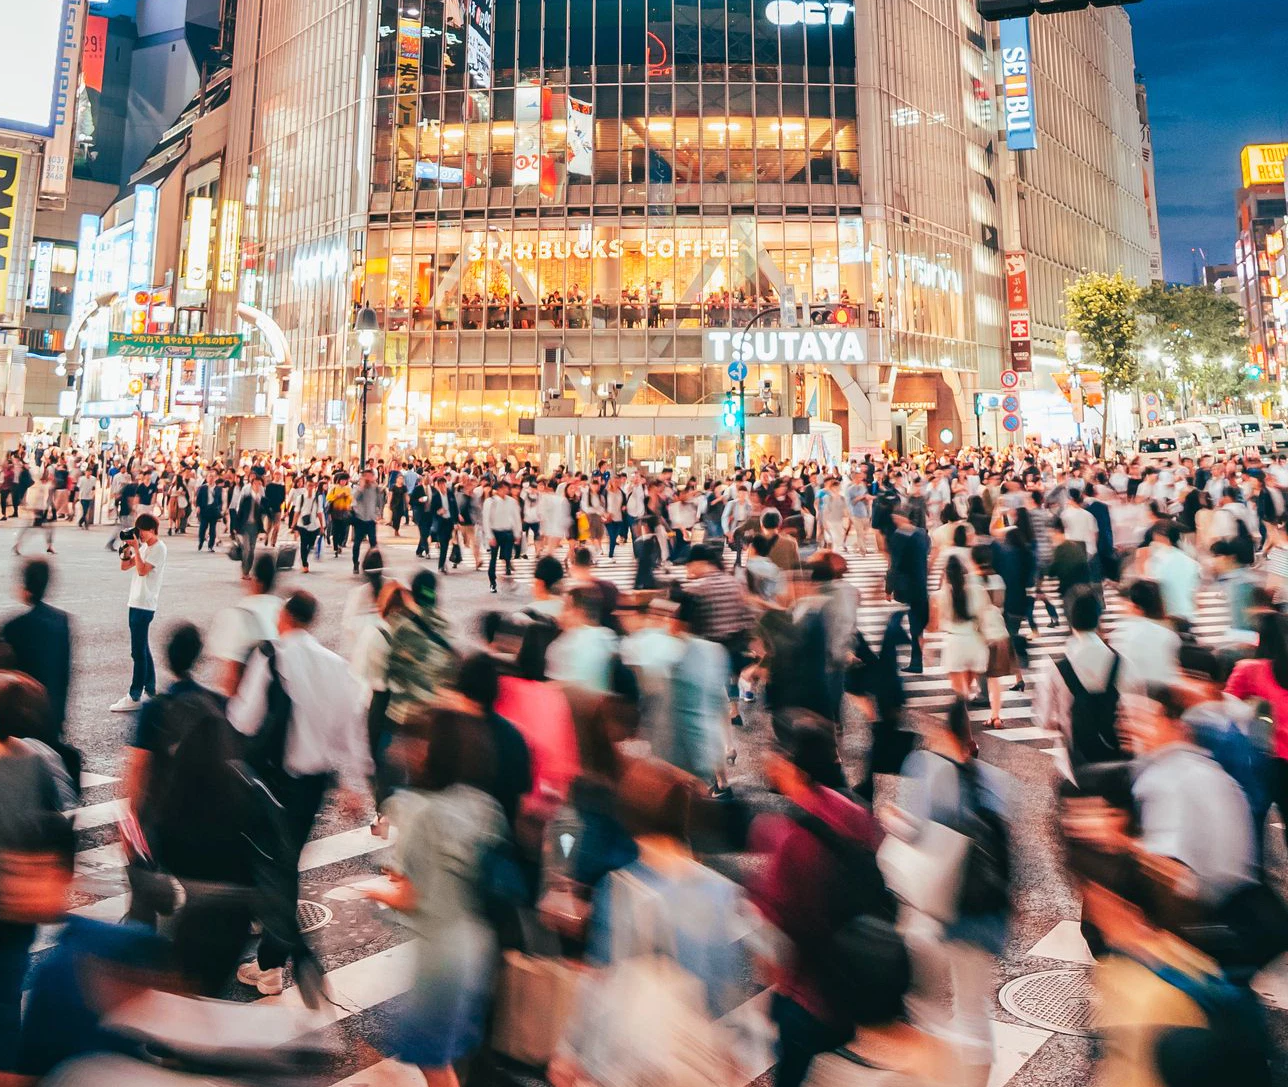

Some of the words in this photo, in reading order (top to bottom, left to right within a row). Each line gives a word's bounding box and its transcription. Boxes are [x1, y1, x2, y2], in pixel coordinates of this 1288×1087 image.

[1002, 47, 1031, 135] SEIBU
[467, 239, 625, 262] STARBUCKS
[640, 238, 740, 258] COFFEE
[1013, 321, 1027, 336] 本
[709, 332, 864, 361] TSUTAYA
